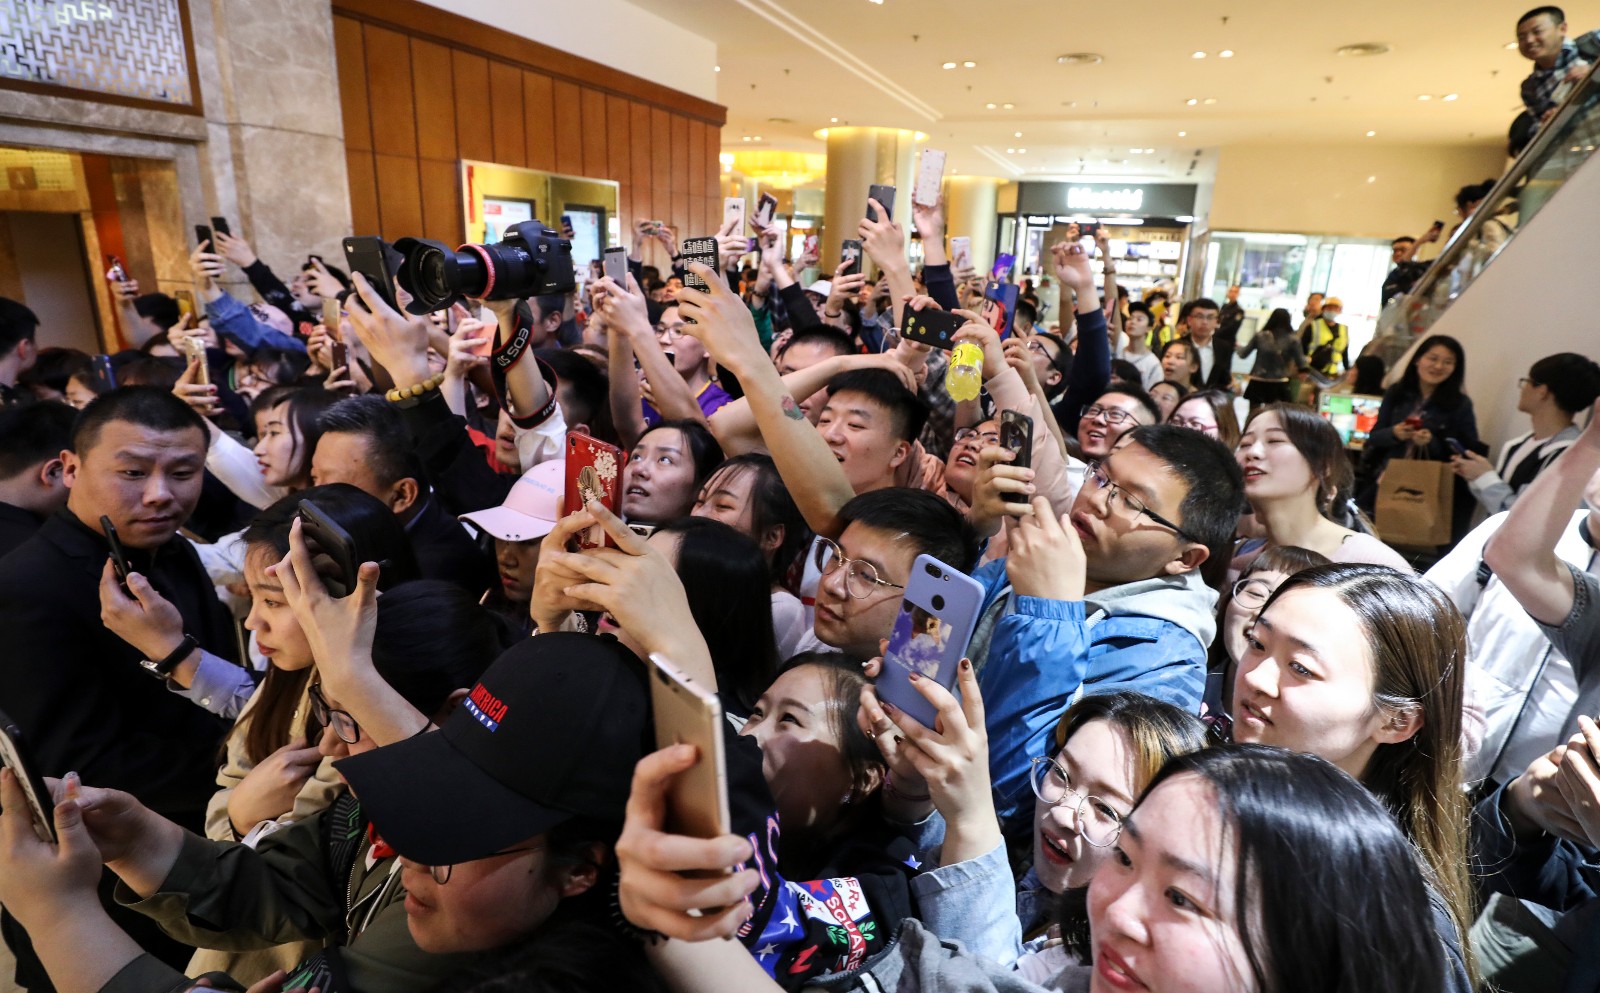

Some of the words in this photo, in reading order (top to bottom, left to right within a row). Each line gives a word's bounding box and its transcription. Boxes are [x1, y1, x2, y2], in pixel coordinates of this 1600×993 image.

[507, 327, 529, 358] EOS
[469, 682, 509, 724] AMERICA
[827, 896, 864, 972] SQUARE
